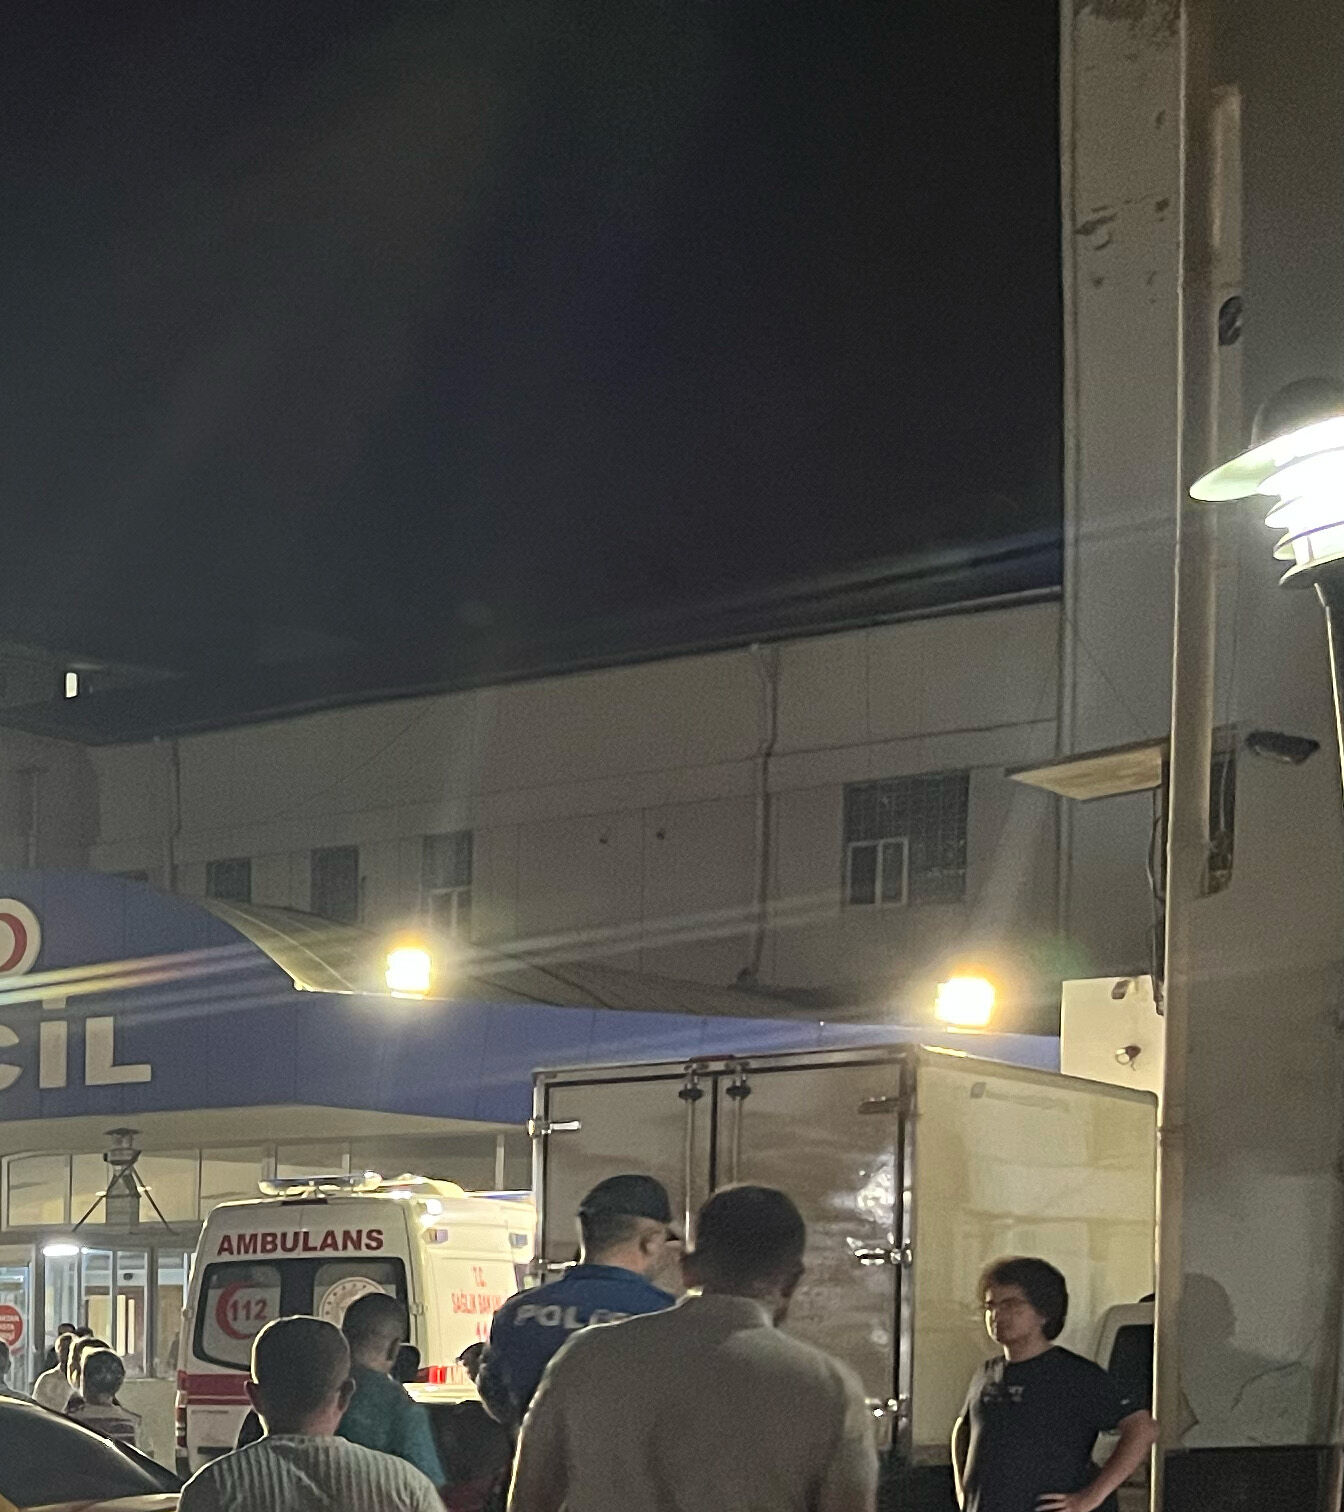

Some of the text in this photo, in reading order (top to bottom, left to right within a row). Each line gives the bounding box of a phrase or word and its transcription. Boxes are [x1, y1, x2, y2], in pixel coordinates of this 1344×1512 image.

[217, 1229, 384, 1256] AMBULANS
[229, 1299, 268, 1322] 112
[514, 1304, 633, 1329] POL
